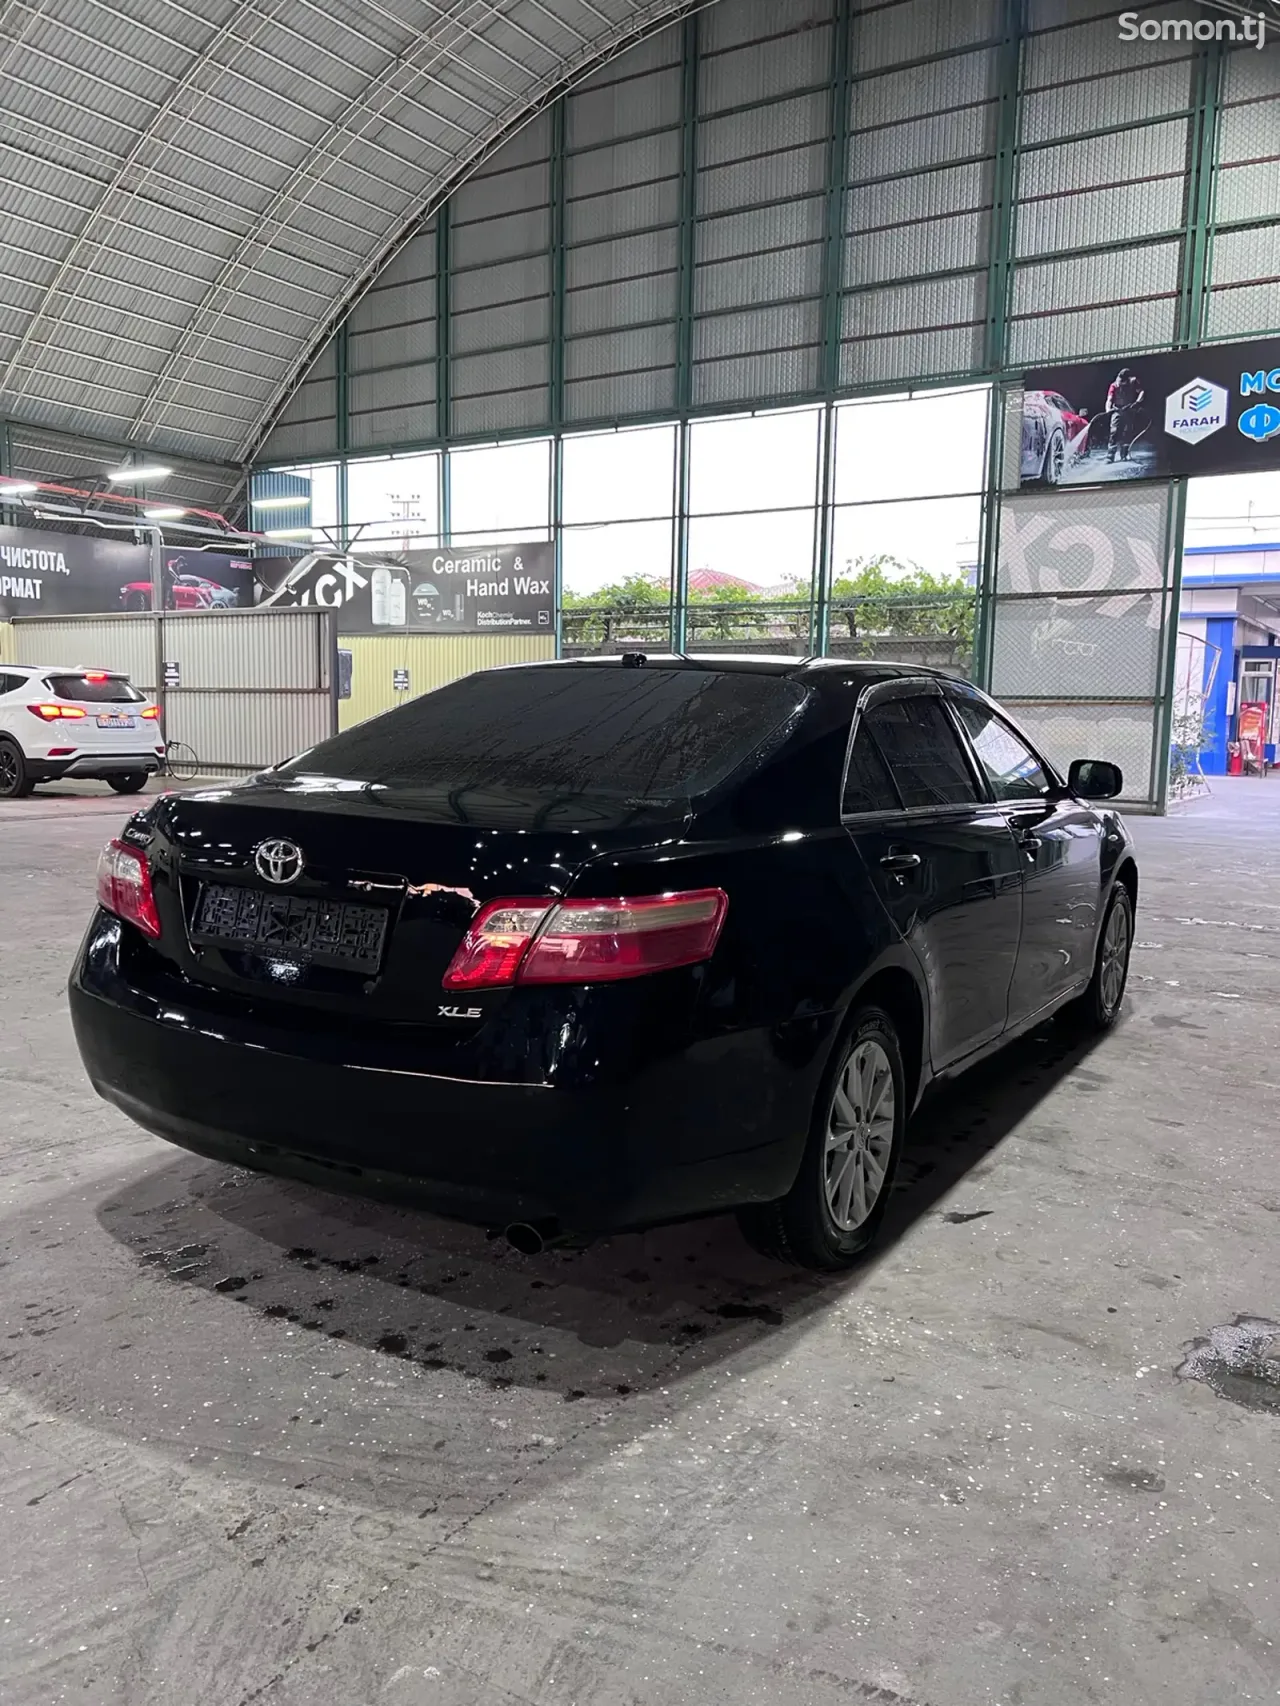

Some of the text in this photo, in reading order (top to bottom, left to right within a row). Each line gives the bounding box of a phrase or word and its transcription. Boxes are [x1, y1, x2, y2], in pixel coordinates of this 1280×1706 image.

[1172, 415, 1220, 428] FARAH
[1, 545, 70, 576] ЧИСТОТА,
[432, 553, 524, 574] Ceramic &
[0, 576, 42, 599] РМАТ
[466, 576, 550, 597] Hand Wax
[437, 1005, 482, 1018] XLE
